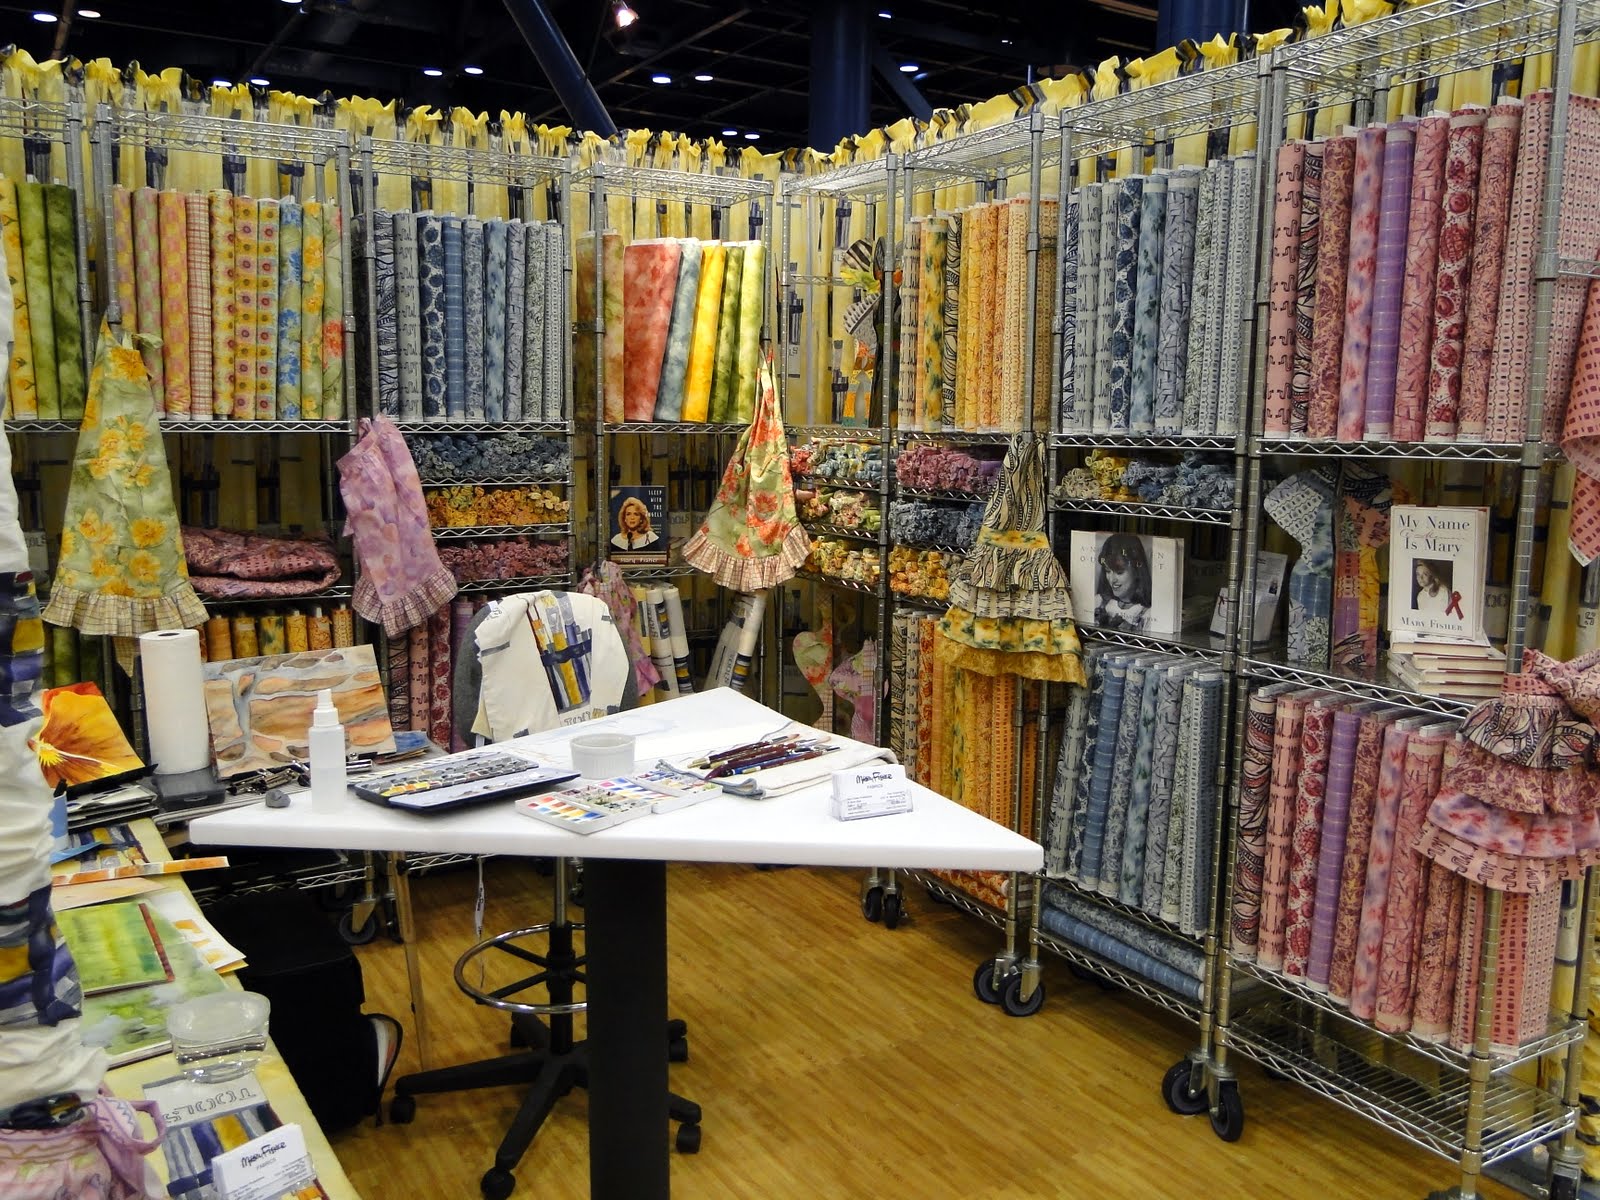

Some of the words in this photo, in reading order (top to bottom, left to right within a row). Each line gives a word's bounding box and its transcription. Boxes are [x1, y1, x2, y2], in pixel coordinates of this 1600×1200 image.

[1399, 514, 1419, 532] My
[1427, 515, 1470, 530] Name
[1405, 537, 1418, 550] Is
[1425, 538, 1462, 557] Mary
[1400, 616, 1425, 628] MARY
[1430, 619, 1464, 631] FISHER
[162, 1087, 257, 1124] TOOLS
